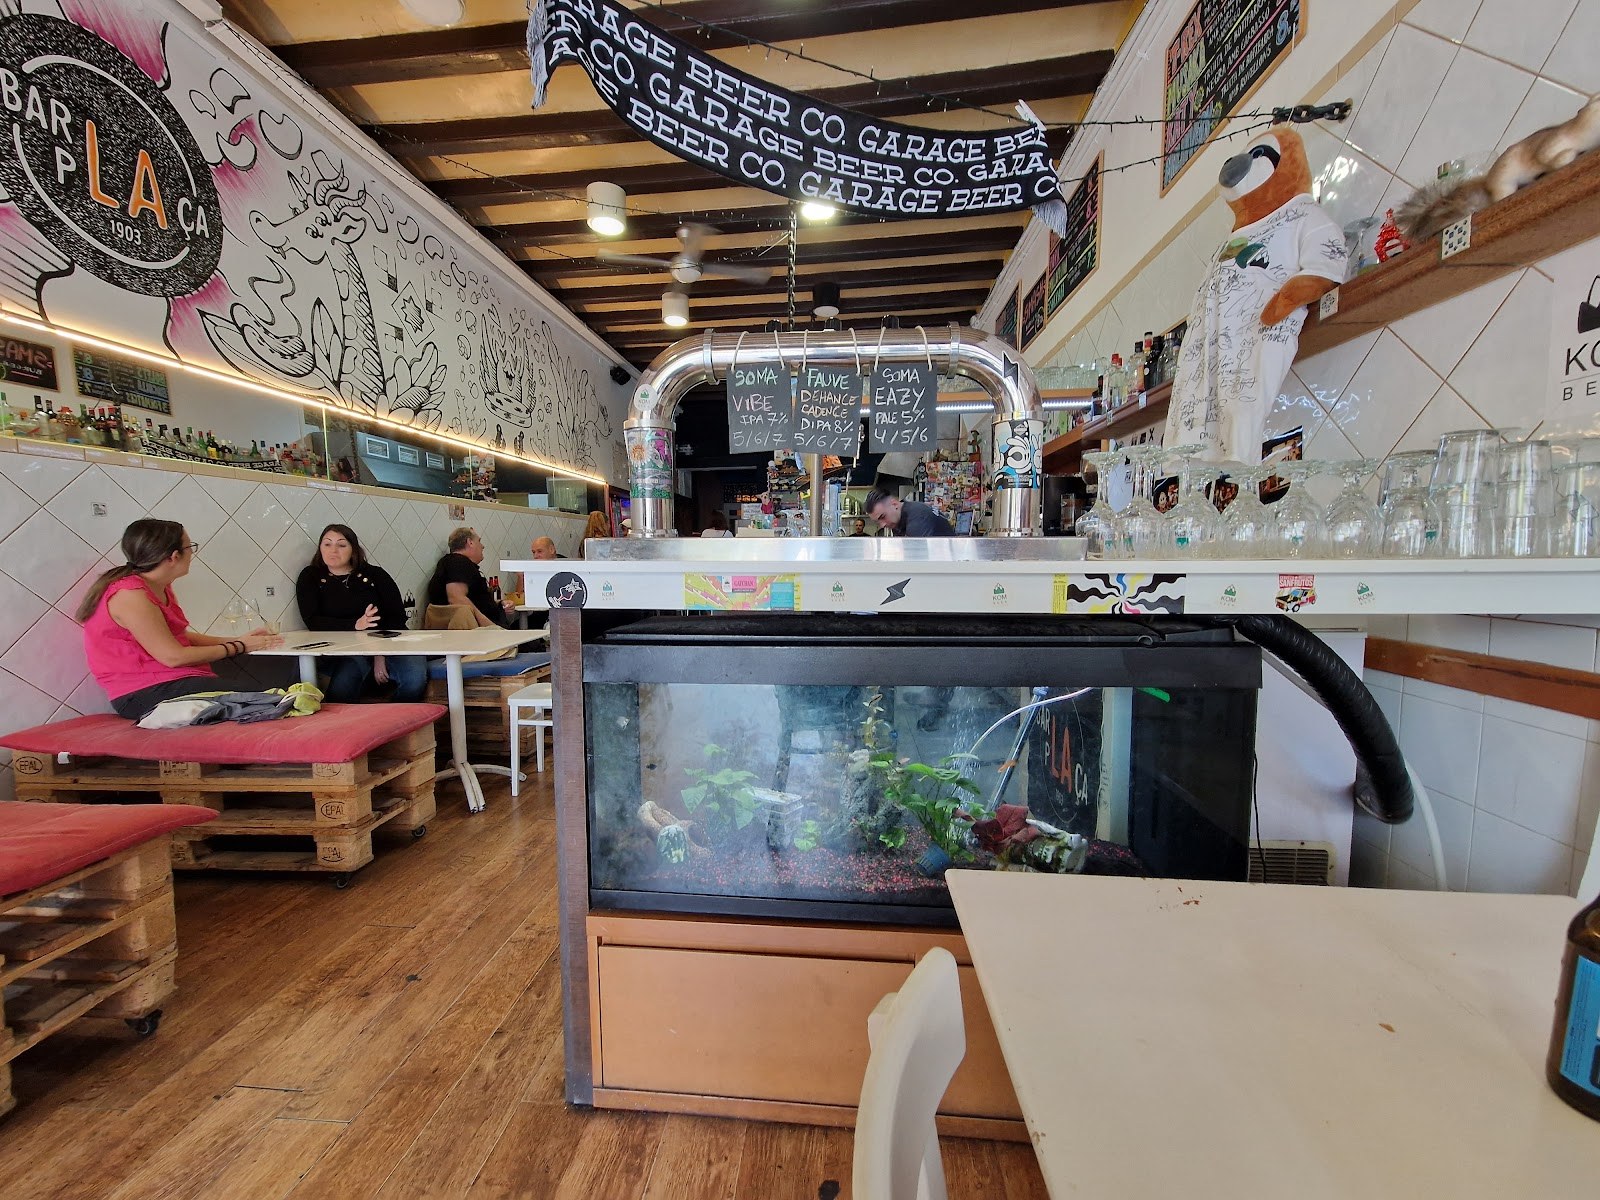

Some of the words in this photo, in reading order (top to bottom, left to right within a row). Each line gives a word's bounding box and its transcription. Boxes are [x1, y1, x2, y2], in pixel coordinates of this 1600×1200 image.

[1224, 40, 1233, 56] DE
[0, 67, 73, 144] BAR
[590, 39, 638, 90] CO.
[649, 72, 804, 161] GARAGE
[813, 146, 907, 185] BEER
[914, 167, 959, 187] CO.
[686, 55, 791, 127] BEER
[800, 107, 846, 146] CO.
[858, 125, 986, 163] GARAGE
[626, 97, 729, 169] BEER
[739, 151, 787, 189] CO.
[799, 171, 941, 213] GARAGE
[946, 183, 1023, 212] BEER
[109, 219, 143, 246] 1903
[735, 368, 778, 387] SOMA
[807, 368, 850, 390] FAUVE
[882, 367, 920, 384] SOMA
[732, 394, 774, 412] VIBE
[875, 387, 926, 412] EAZY
[740, 414, 764, 425] IPA
[801, 418, 832, 432] DIPA
[834, 419, 854, 434] 8%
[876, 411, 898, 425] PALE
[901, 409, 925, 425] 5%
[19, 760, 40, 771] EPAL
